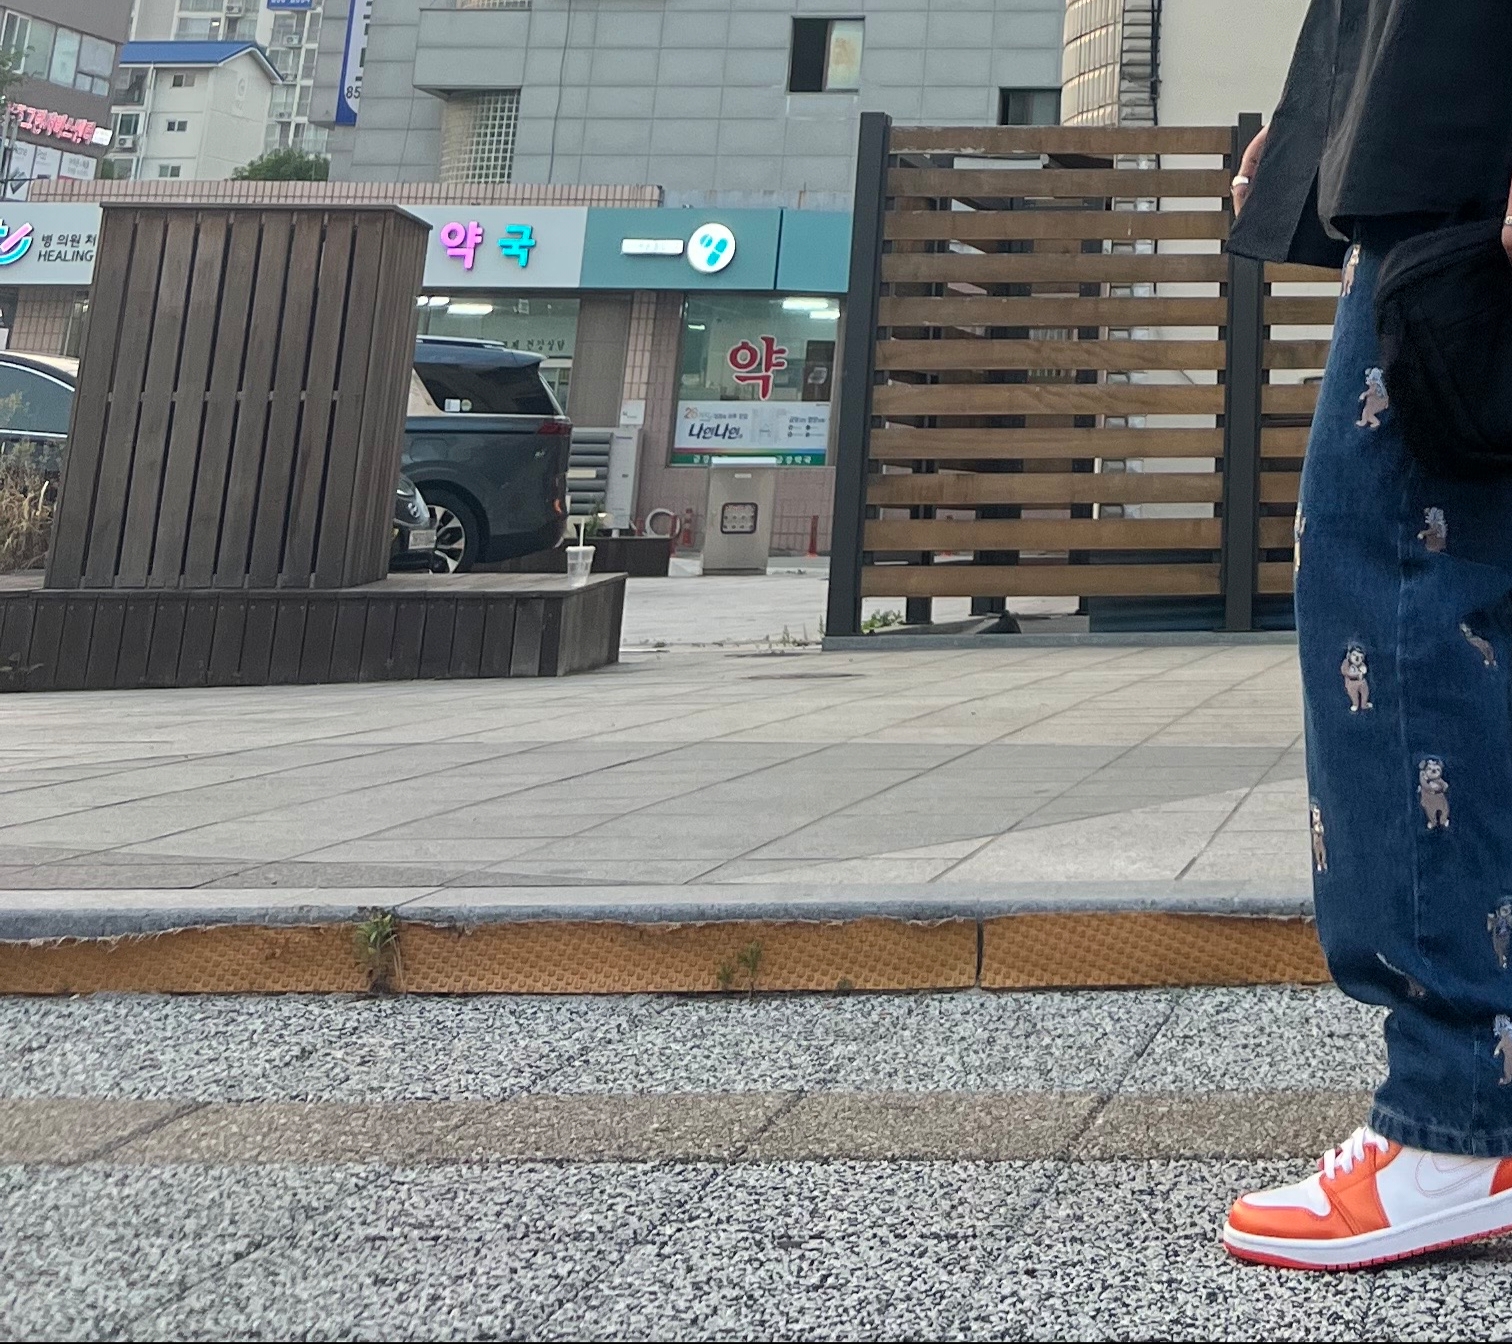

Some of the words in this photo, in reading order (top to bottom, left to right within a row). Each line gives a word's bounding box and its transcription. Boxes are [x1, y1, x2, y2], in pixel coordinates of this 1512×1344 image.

[56, 233, 82, 248] 의원
[37, 250, 95, 262] HEALING
[728, 335, 788, 400] 약
